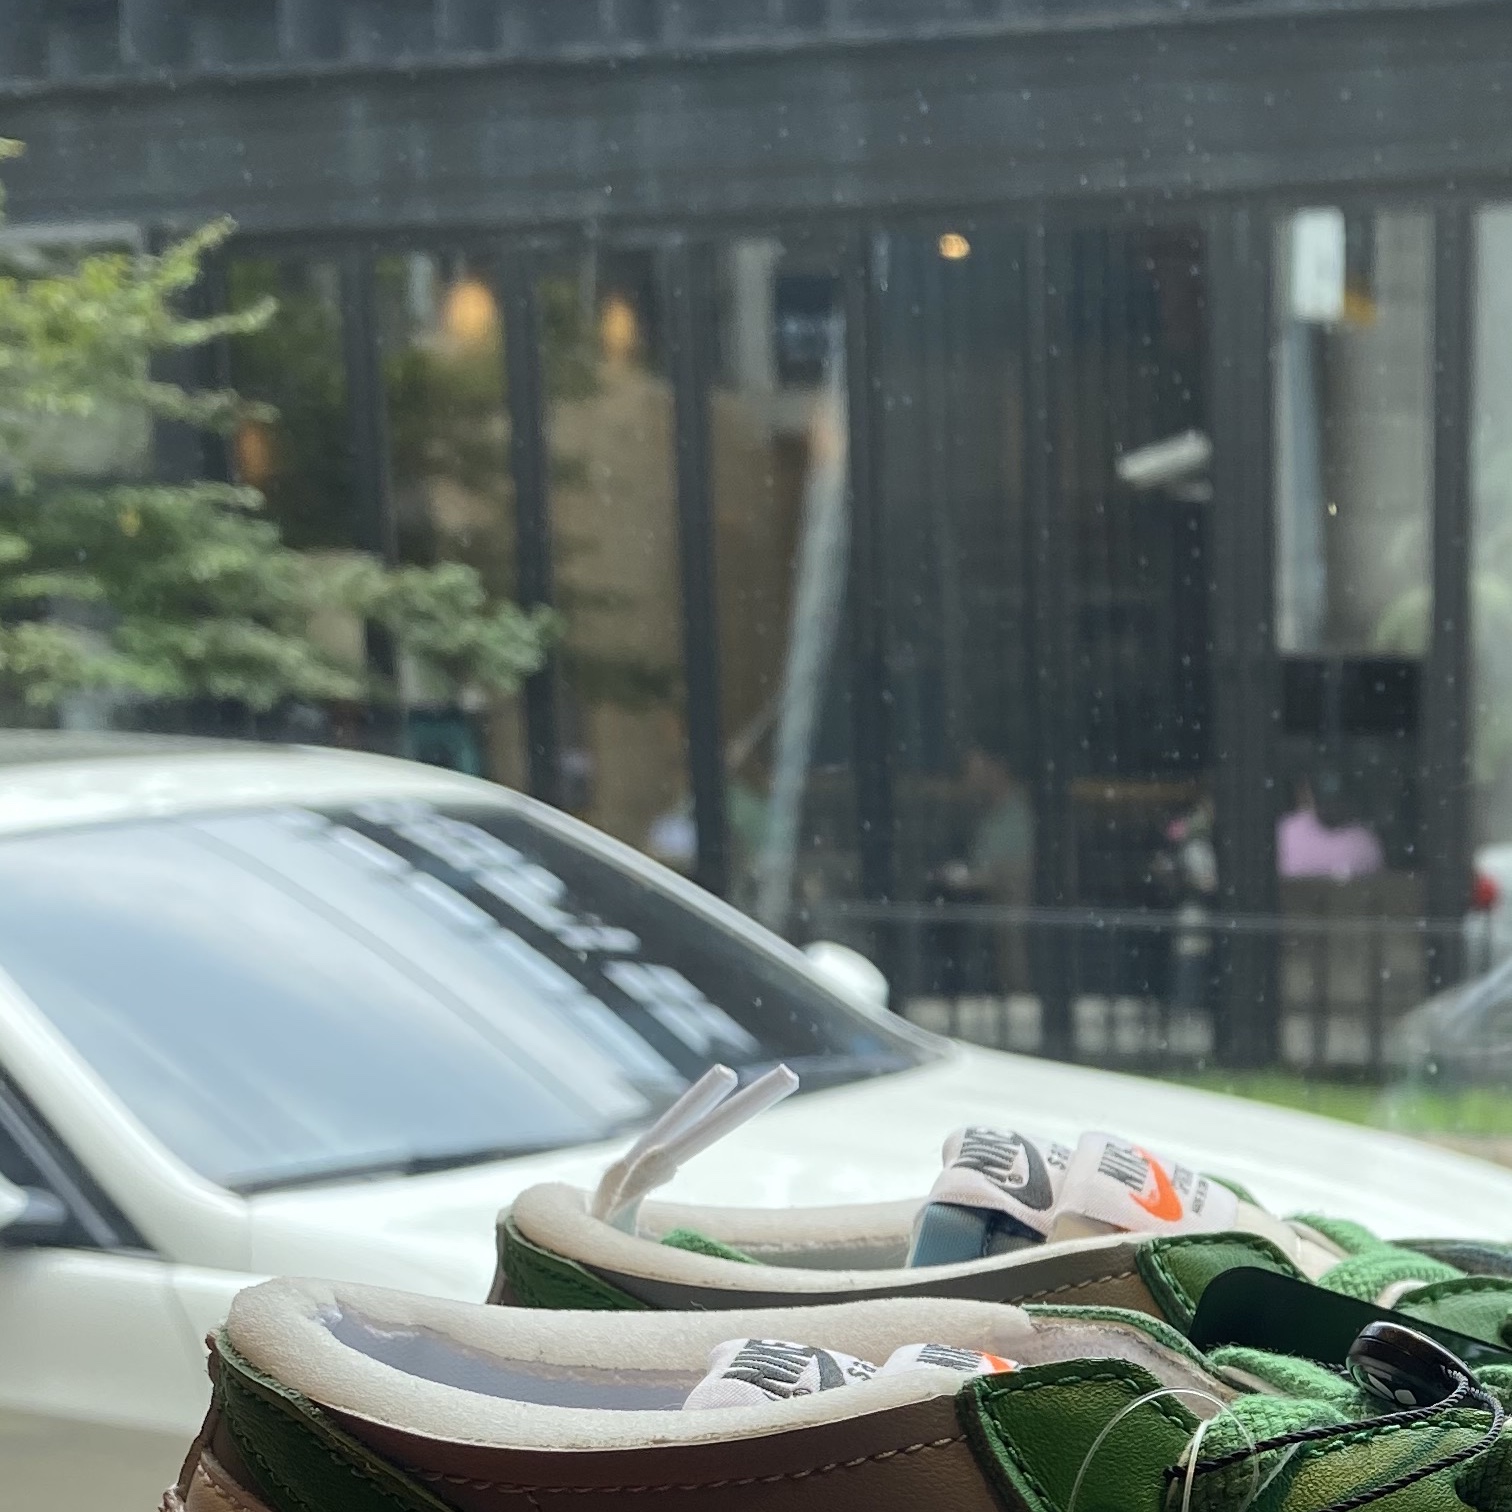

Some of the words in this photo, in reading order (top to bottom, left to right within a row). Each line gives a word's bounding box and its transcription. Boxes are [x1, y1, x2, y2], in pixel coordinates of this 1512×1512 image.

[951, 1127, 1019, 1183] NIKE
[1097, 1141, 1149, 1192] NIKE
[721, 1338, 815, 1399] NIKE
